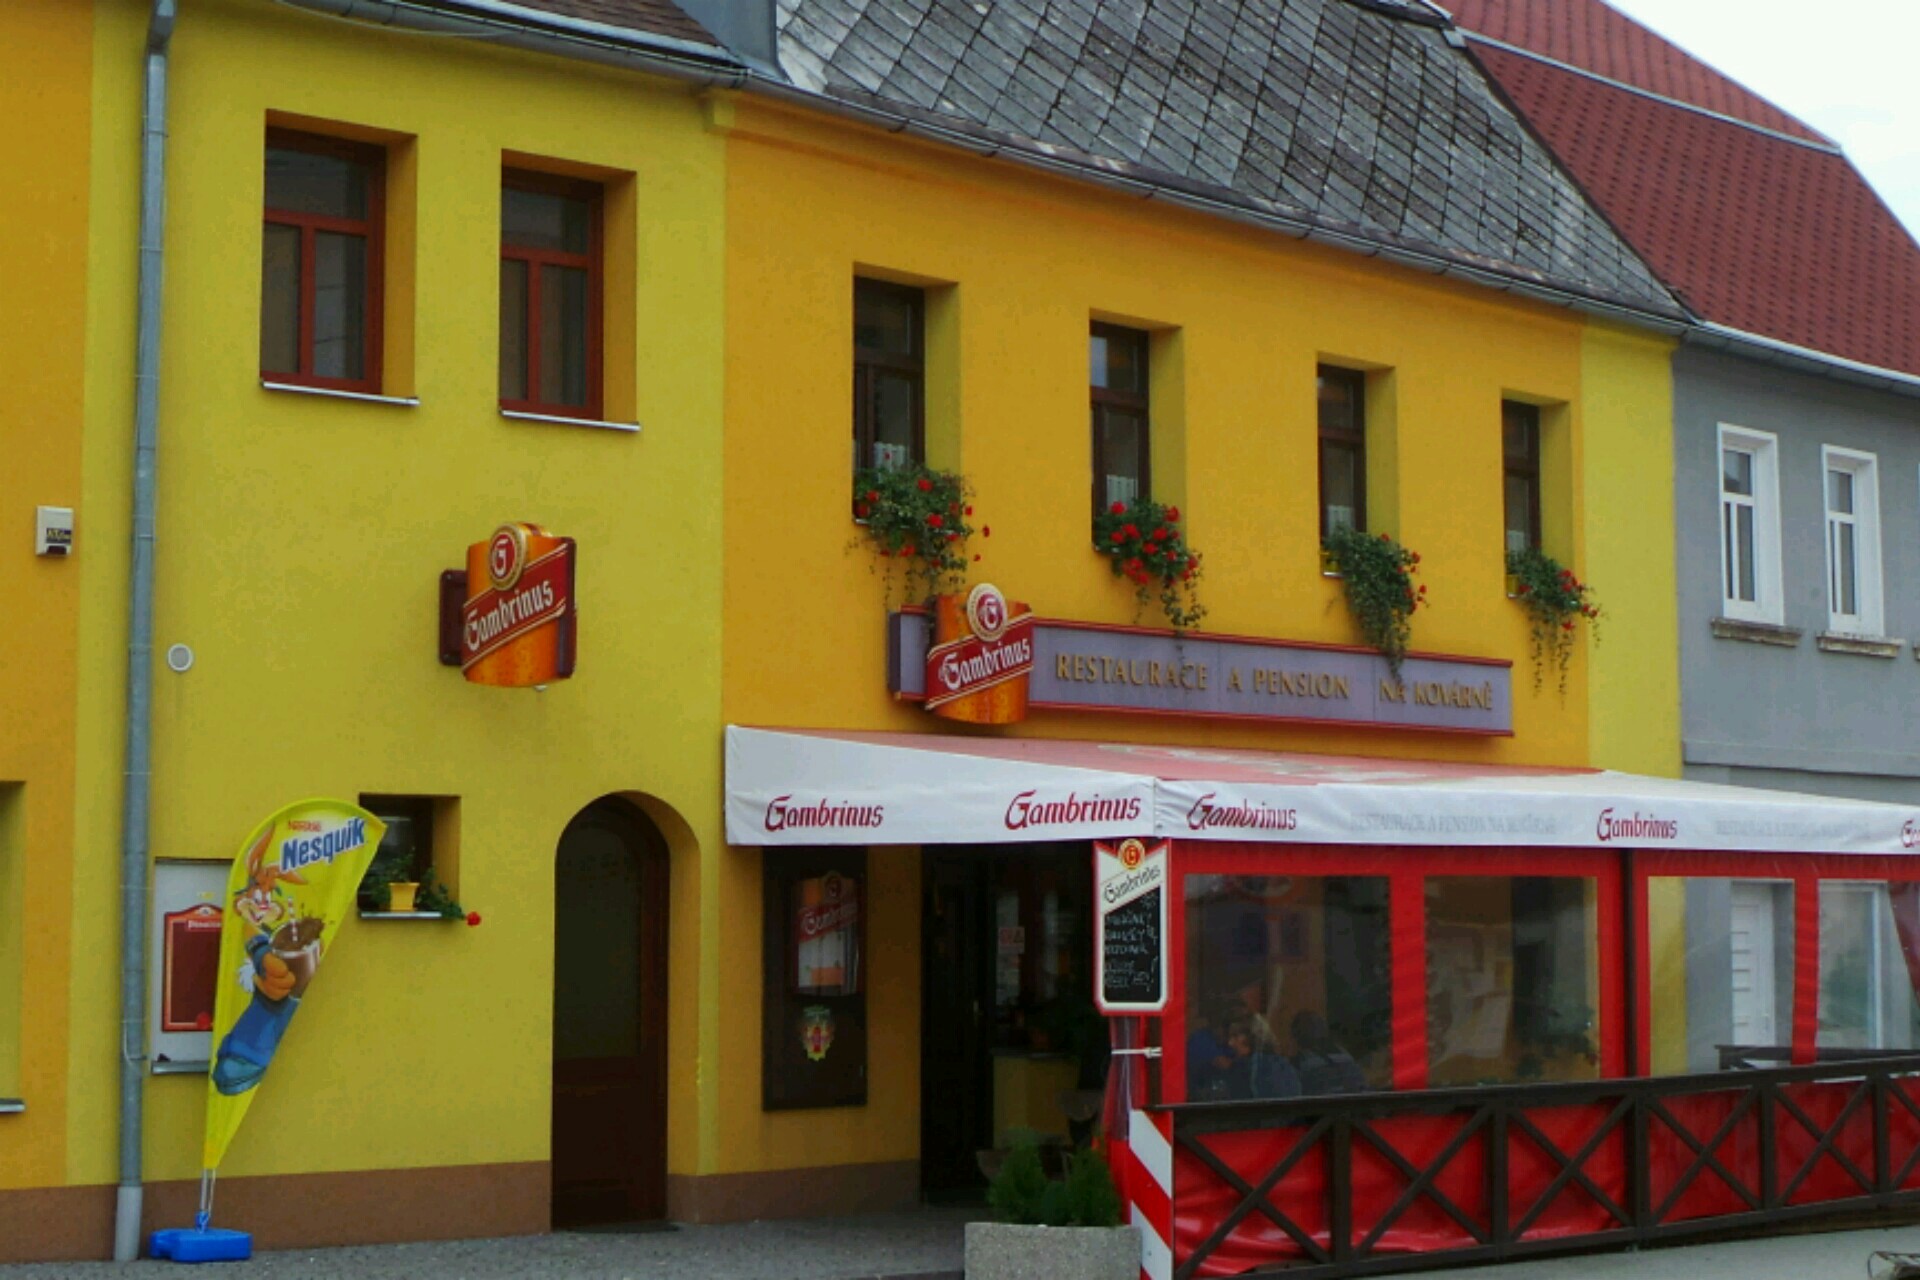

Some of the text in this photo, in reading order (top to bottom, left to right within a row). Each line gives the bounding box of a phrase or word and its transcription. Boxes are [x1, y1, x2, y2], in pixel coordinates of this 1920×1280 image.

[464, 580, 554, 651] Gambrinus
[938, 637, 1031, 690] Gambrinus
[1228, 667, 1243, 693] A
[1253, 667, 1350, 700] PENSION
[764, 794, 884, 832] Gambrinus
[1004, 789, 1142, 831] Gambrinus
[1186, 792, 1297, 831] Gambrinus
[1596, 808, 1678, 842] Gambrinus
[281, 816, 365, 872] Nesquik
